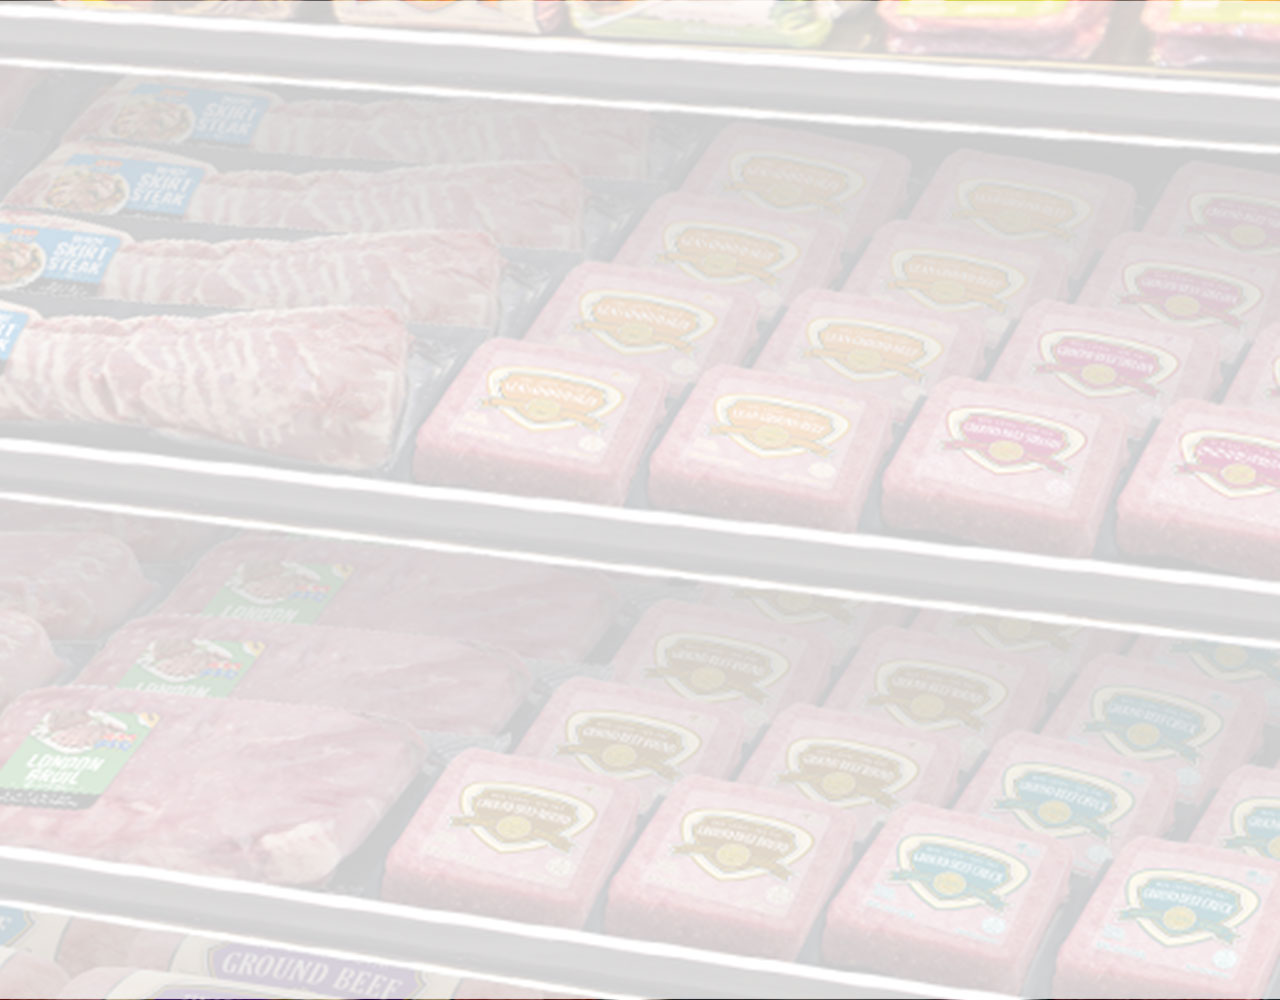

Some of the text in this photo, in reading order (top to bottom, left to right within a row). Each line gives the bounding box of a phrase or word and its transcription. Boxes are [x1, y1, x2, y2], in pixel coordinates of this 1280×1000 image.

[47, 258, 103, 276] STEAK
[25, 753, 106, 771] LONDON
[222, 951, 404, 998] GROUND BEEF
